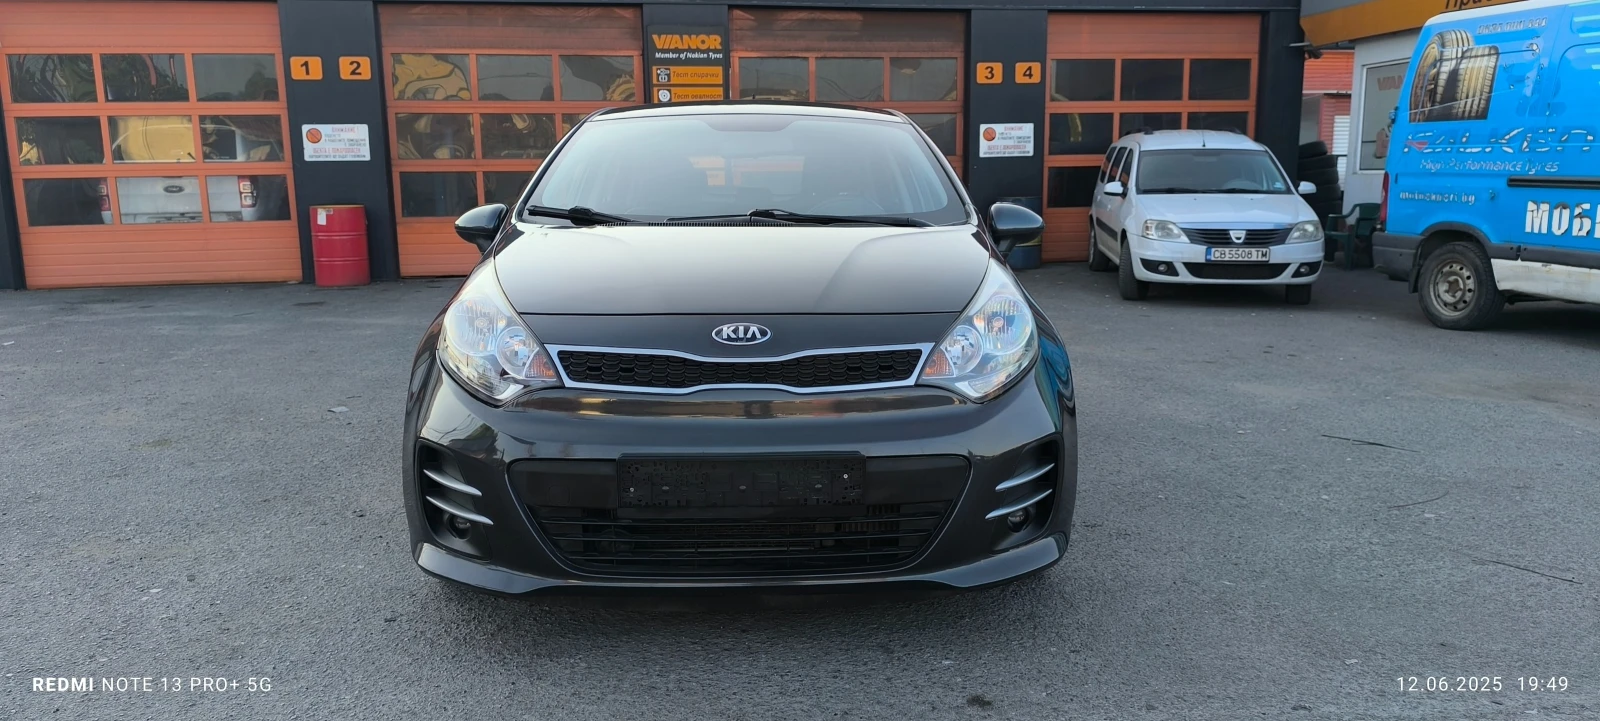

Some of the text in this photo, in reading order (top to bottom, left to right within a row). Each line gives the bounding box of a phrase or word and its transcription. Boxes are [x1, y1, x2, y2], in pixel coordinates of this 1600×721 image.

[652, 34, 722, 50] VIANOR
[680, 52, 687, 60] of
[709, 52, 723, 60] Tyres
[300, 60, 310, 76] 1
[349, 60, 362, 76] 2
[984, 66, 995, 80] 3
[1022, 66, 1034, 80] 4
[1213, 249, 1268, 260] CB 5508 TM
[722, 326, 762, 339] KIA
